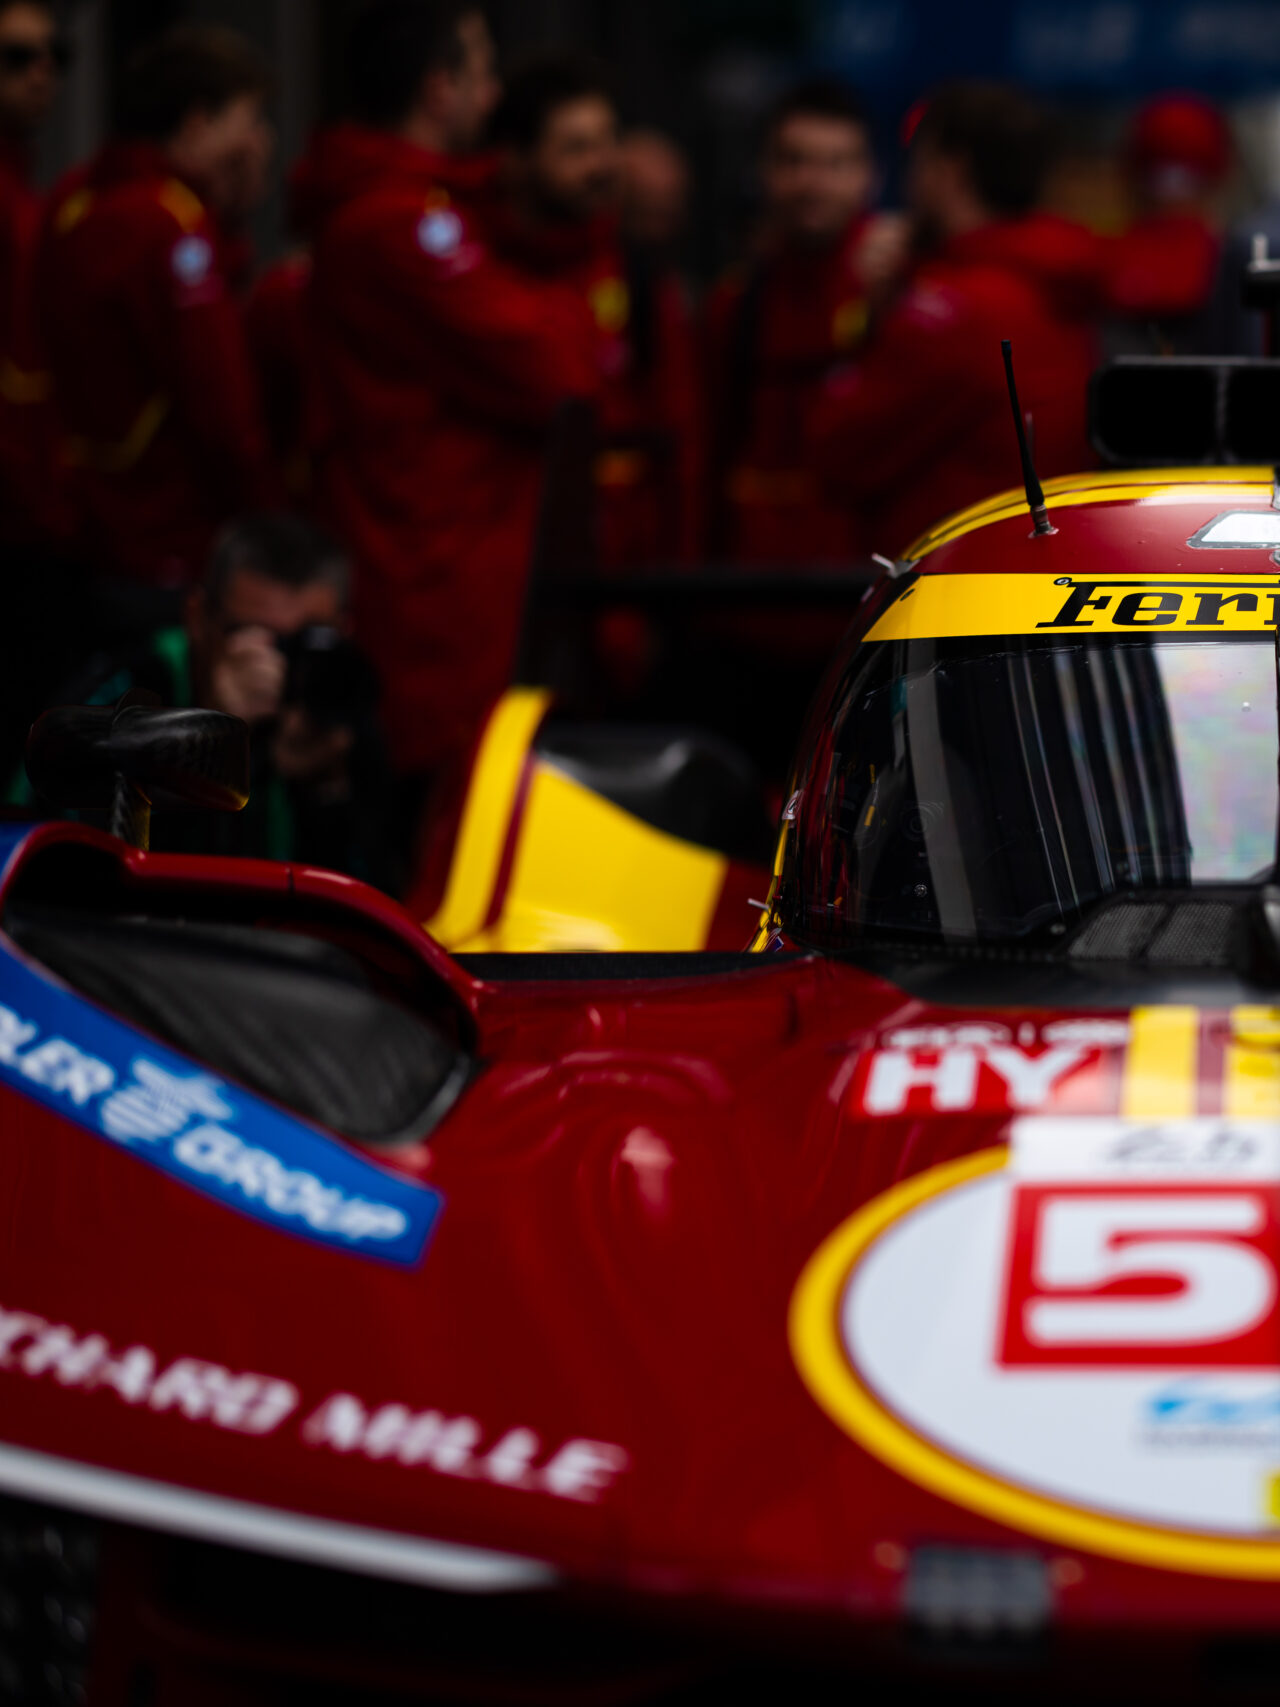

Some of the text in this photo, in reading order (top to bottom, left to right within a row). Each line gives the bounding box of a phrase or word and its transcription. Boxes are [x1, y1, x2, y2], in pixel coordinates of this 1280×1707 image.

[863, 1046, 1092, 1115] HY
[173, 1124, 408, 1241] GROUP
[302, 1392, 628, 1503] MILLE
